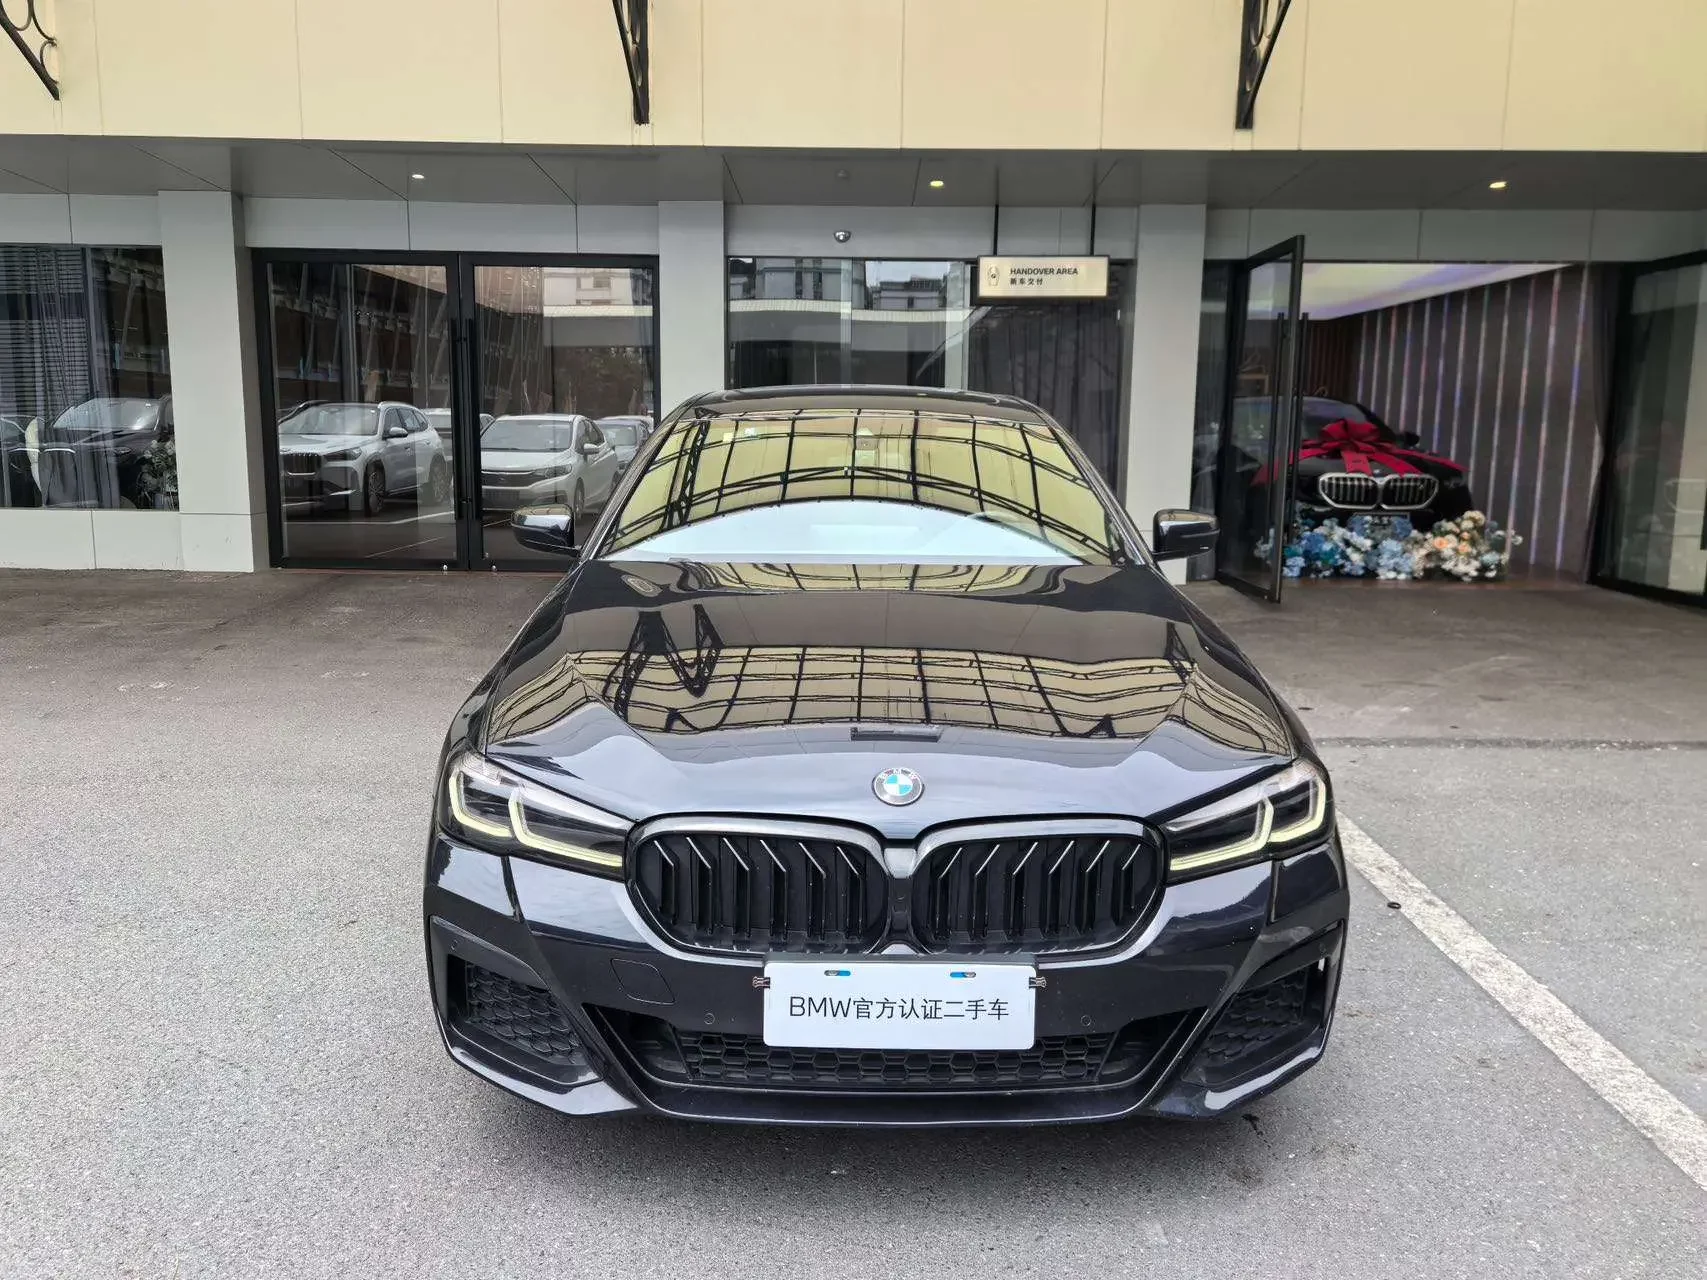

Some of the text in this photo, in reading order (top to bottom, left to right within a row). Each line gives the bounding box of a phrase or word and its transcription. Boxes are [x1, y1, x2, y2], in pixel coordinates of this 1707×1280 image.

[1010, 267, 1078, 275] HANDOVER AREA
[789, 996, 1010, 1021] BMW官方认证二手车
